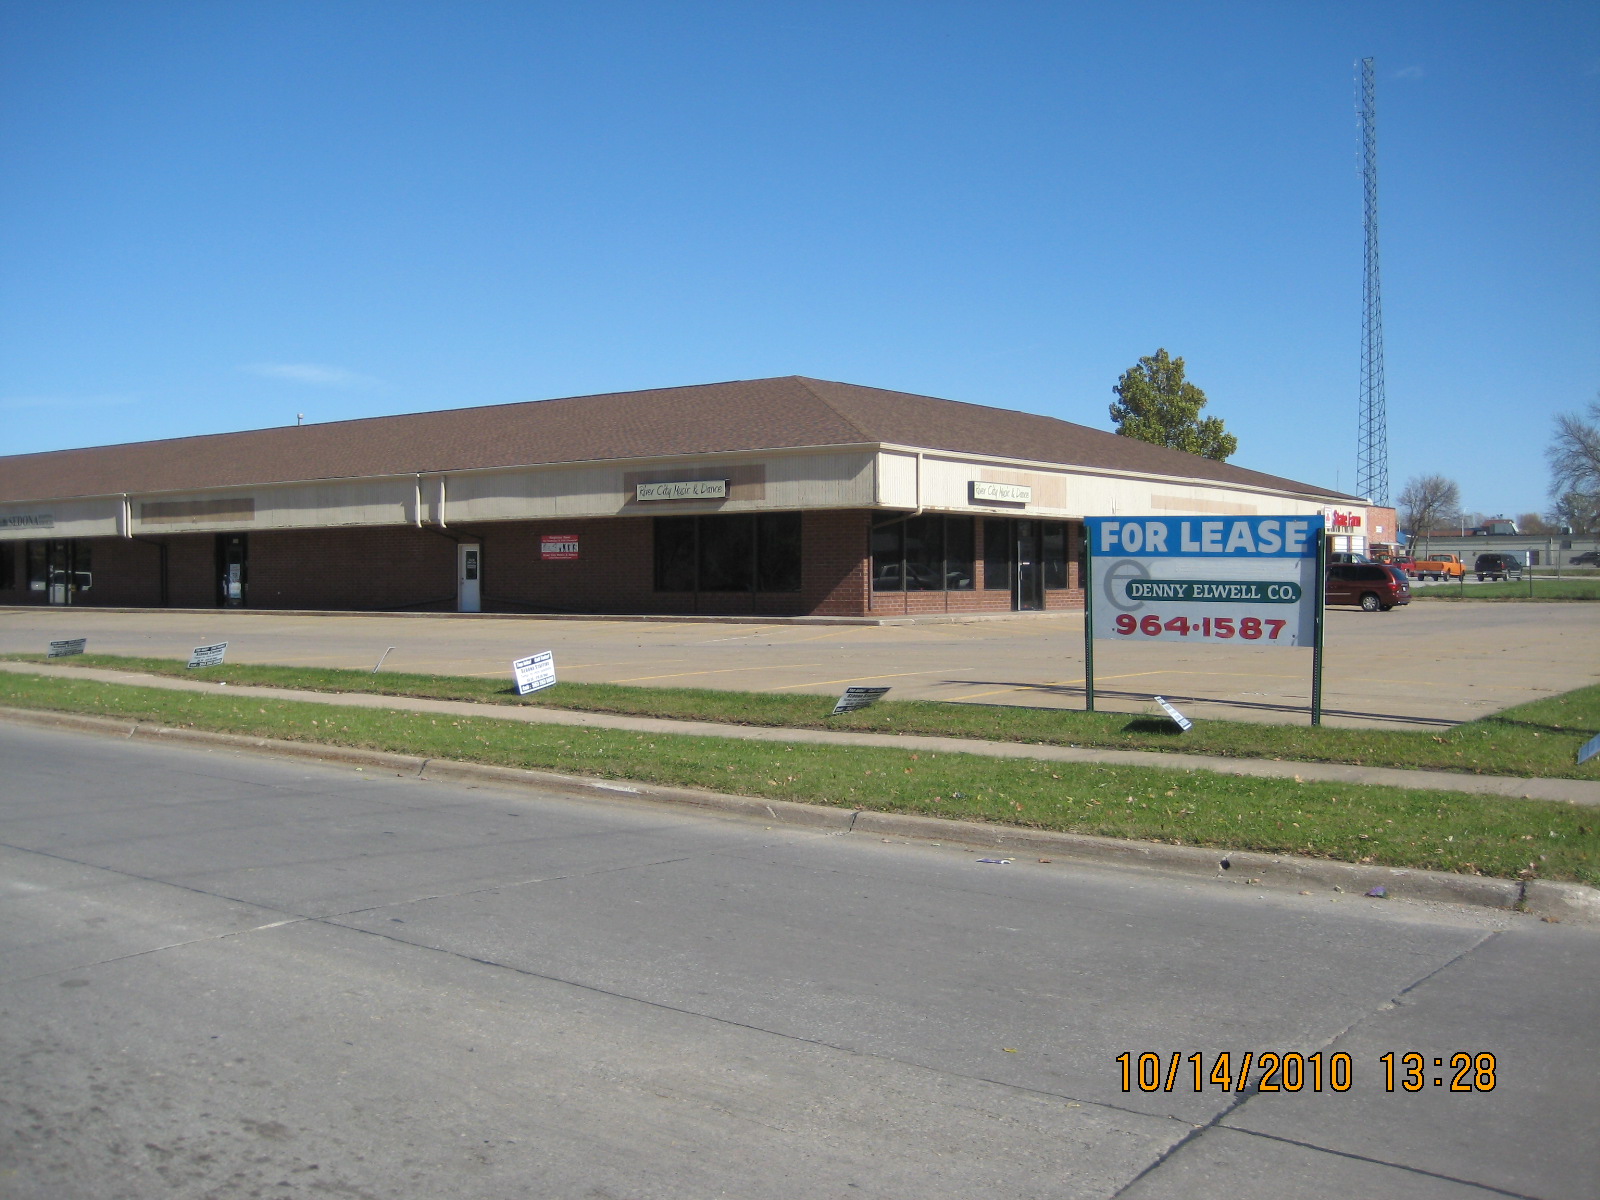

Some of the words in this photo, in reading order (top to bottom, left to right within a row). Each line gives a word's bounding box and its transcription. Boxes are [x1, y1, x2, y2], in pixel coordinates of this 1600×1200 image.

[640, 485, 655, 497] River
[657, 484, 671, 498] City
[673, 483, 691, 496] Music
[693, 484, 699, 495] &
[701, 482, 722, 494] Dance
[9, 515, 39, 526] SEDONA
[1334, 510, 1347, 527] State
[1348, 511, 1361, 527] Farm
[1101, 521, 1168, 552] FOR
[1181, 520, 1308, 553] LEASE
[1131, 583, 1188, 598] DENNY
[1192, 585, 1260, 599] ELWELL
[1268, 585, 1296, 600] CO.
